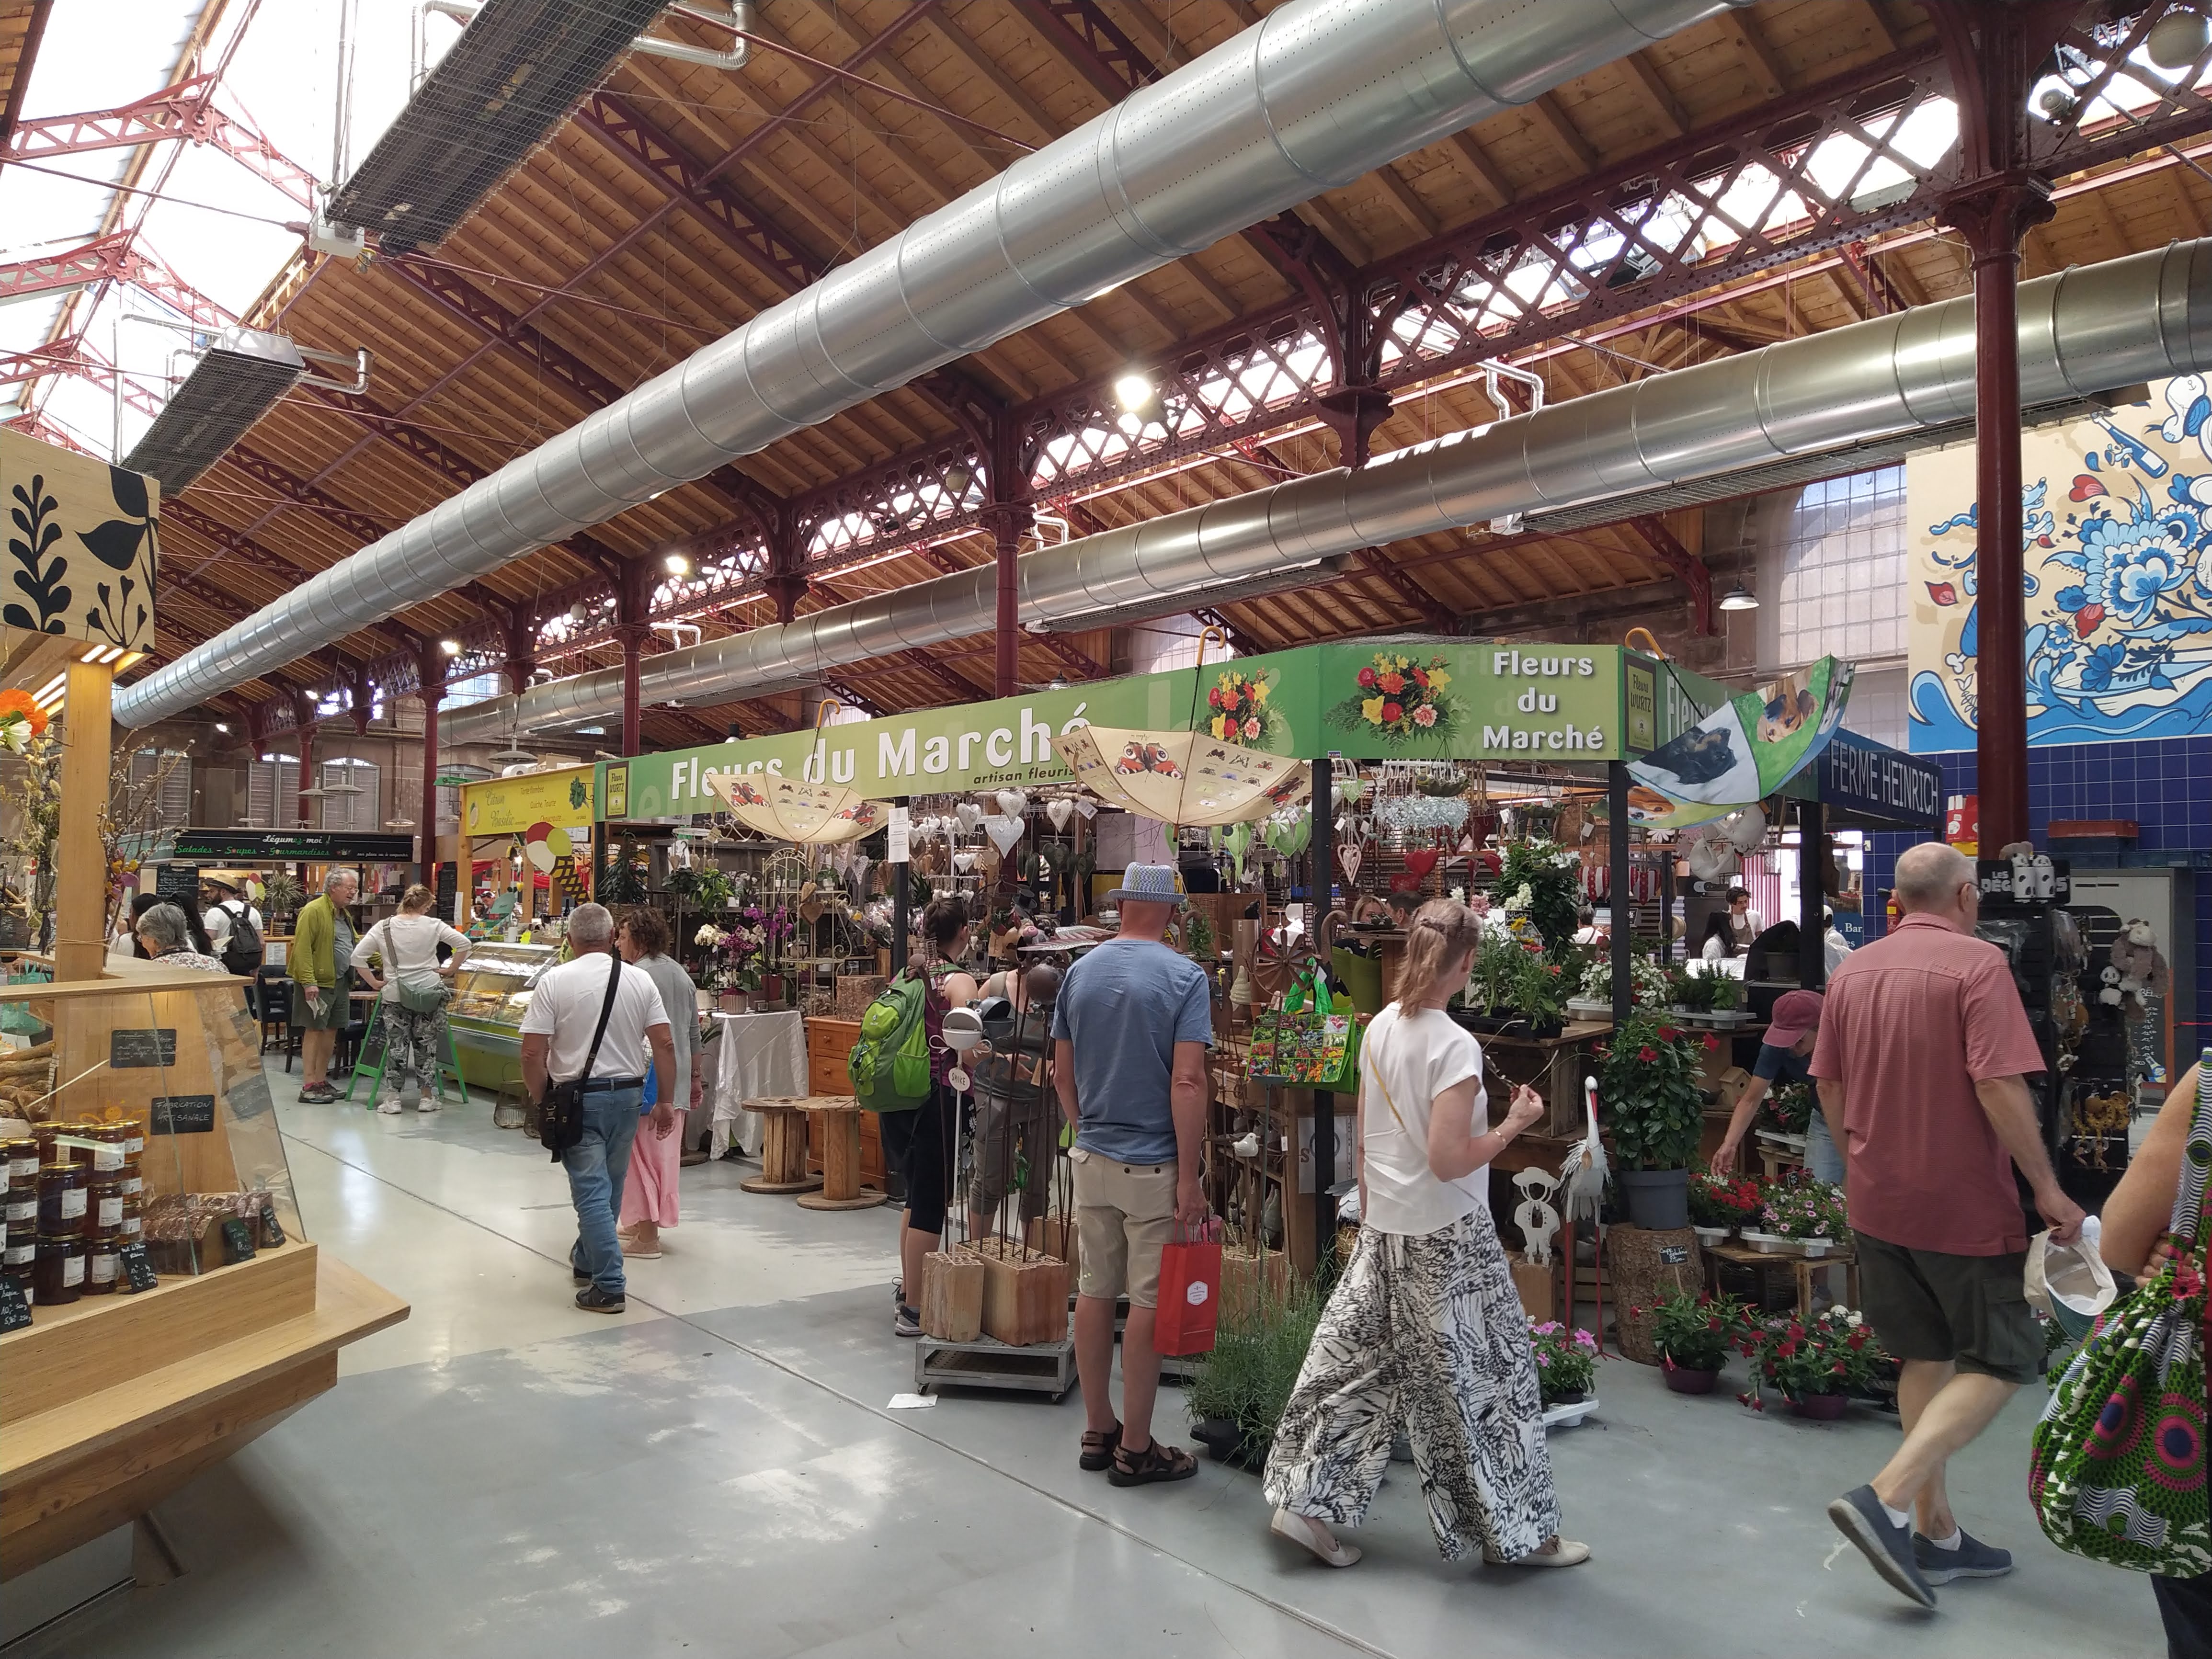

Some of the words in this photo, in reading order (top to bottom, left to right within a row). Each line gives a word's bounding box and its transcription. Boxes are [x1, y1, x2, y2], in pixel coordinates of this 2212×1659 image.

[1494, 651, 1593, 676] Fleurs
[1633, 674, 1649, 693] Fleurs
[1517, 687, 1556, 712] du
[1630, 693, 1652, 713] WURTZ
[1483, 724, 1603, 749] Marché
[803, 739, 855, 784] du
[973, 772, 1022, 784] artisan
[1831, 738, 1878, 801] FERME
[1882, 757, 1938, 816] HEINRICH
[175, 845, 213, 853] Salades
[269, 847, 330, 856] Gourmandises
[1845, 922, 1863, 933] Bar
[951, 1072, 966, 1086] SMOKE
[156, 1101, 212, 1110] FABRICATION
[157, 1112, 210, 1123] ARTISANALE
